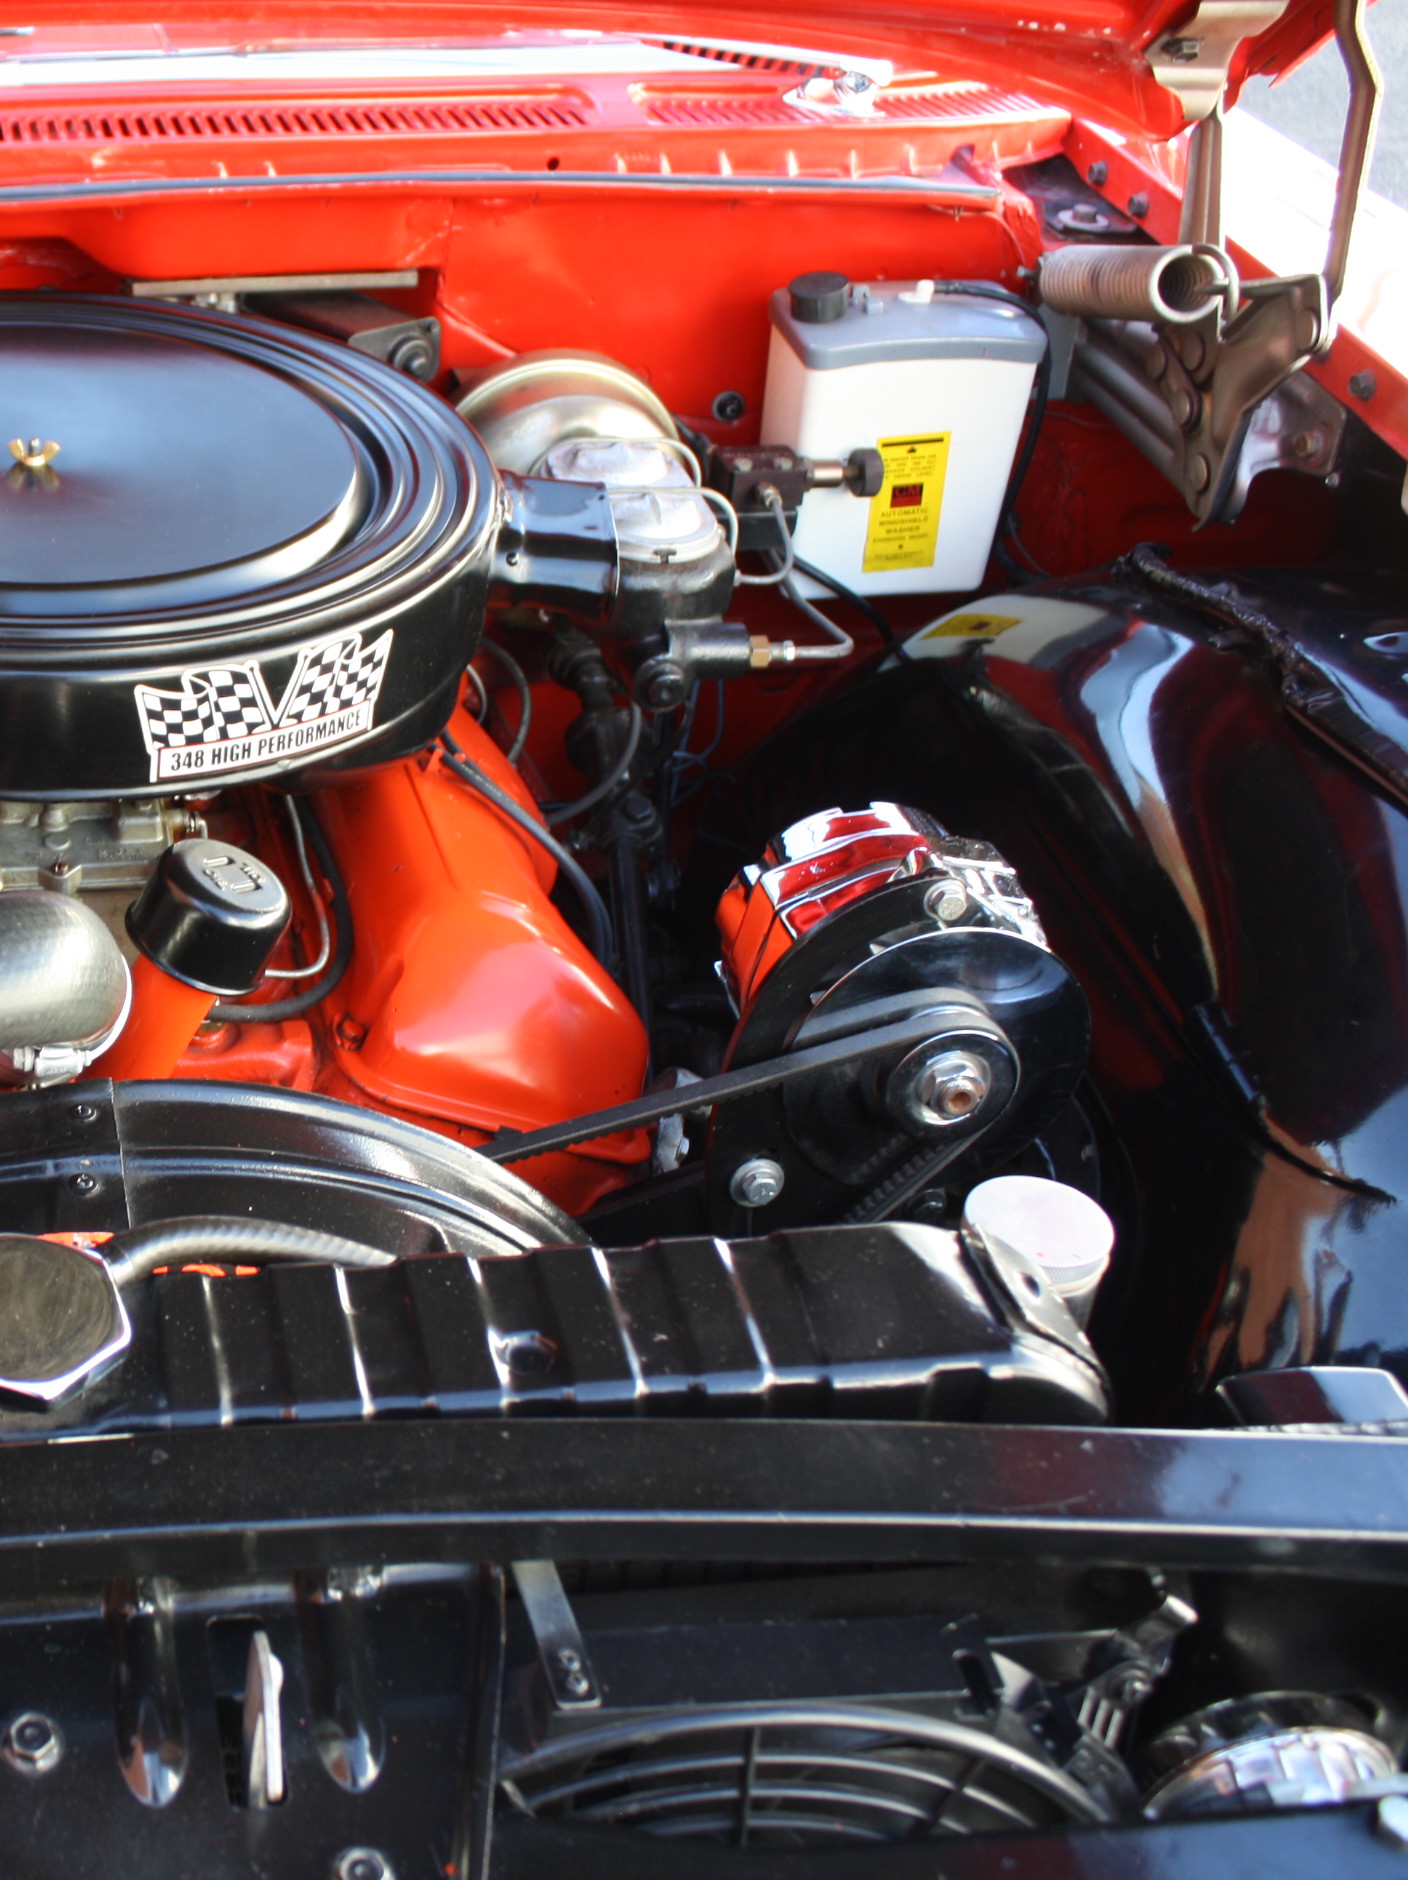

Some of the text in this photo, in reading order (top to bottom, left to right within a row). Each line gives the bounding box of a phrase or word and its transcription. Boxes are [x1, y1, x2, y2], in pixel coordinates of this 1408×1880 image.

[880, 507, 929, 518] AUTOMATIC
[879, 516, 929, 527] WINDSHIELD
[885, 525, 921, 535] WASHER
[170, 708, 362, 772] 348 HIGH PERFORMANCE
